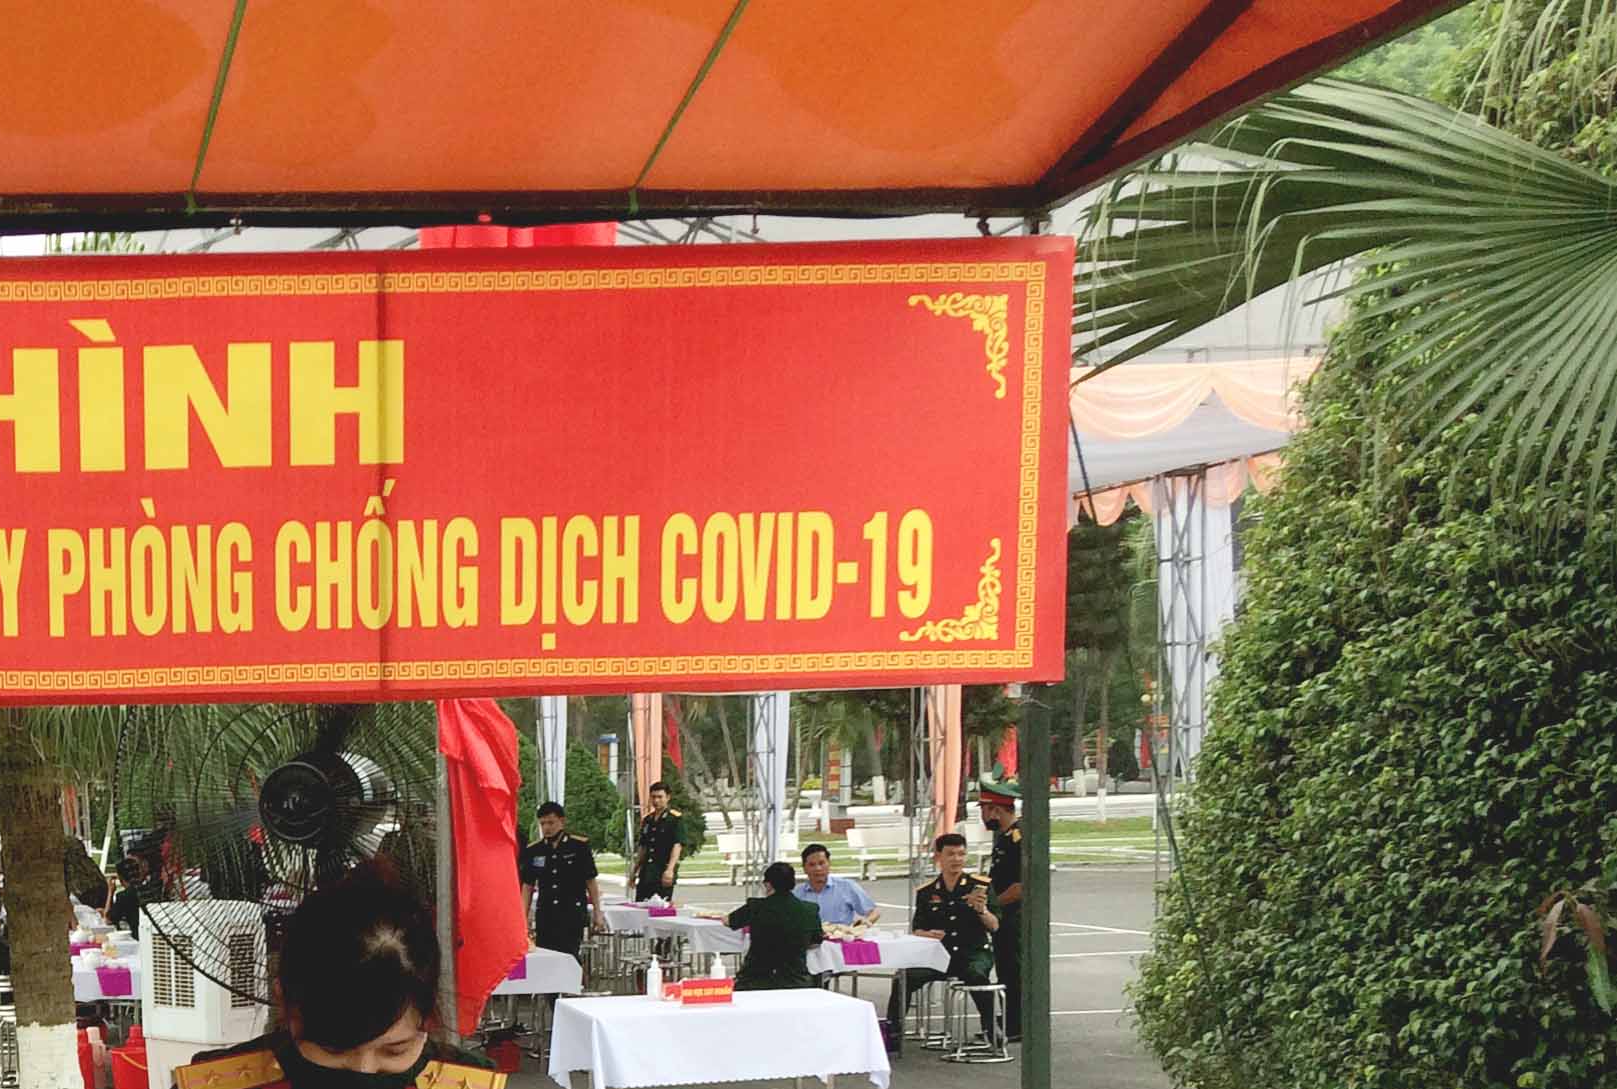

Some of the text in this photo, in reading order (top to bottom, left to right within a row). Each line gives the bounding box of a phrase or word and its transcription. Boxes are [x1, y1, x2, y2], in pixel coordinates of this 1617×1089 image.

[48, 498, 253, 637] PHÒNG
[274, 478, 479, 632] CHỐNG
[500, 514, 641, 650] DỊCH
[661, 508, 933, 624] COVID-19
